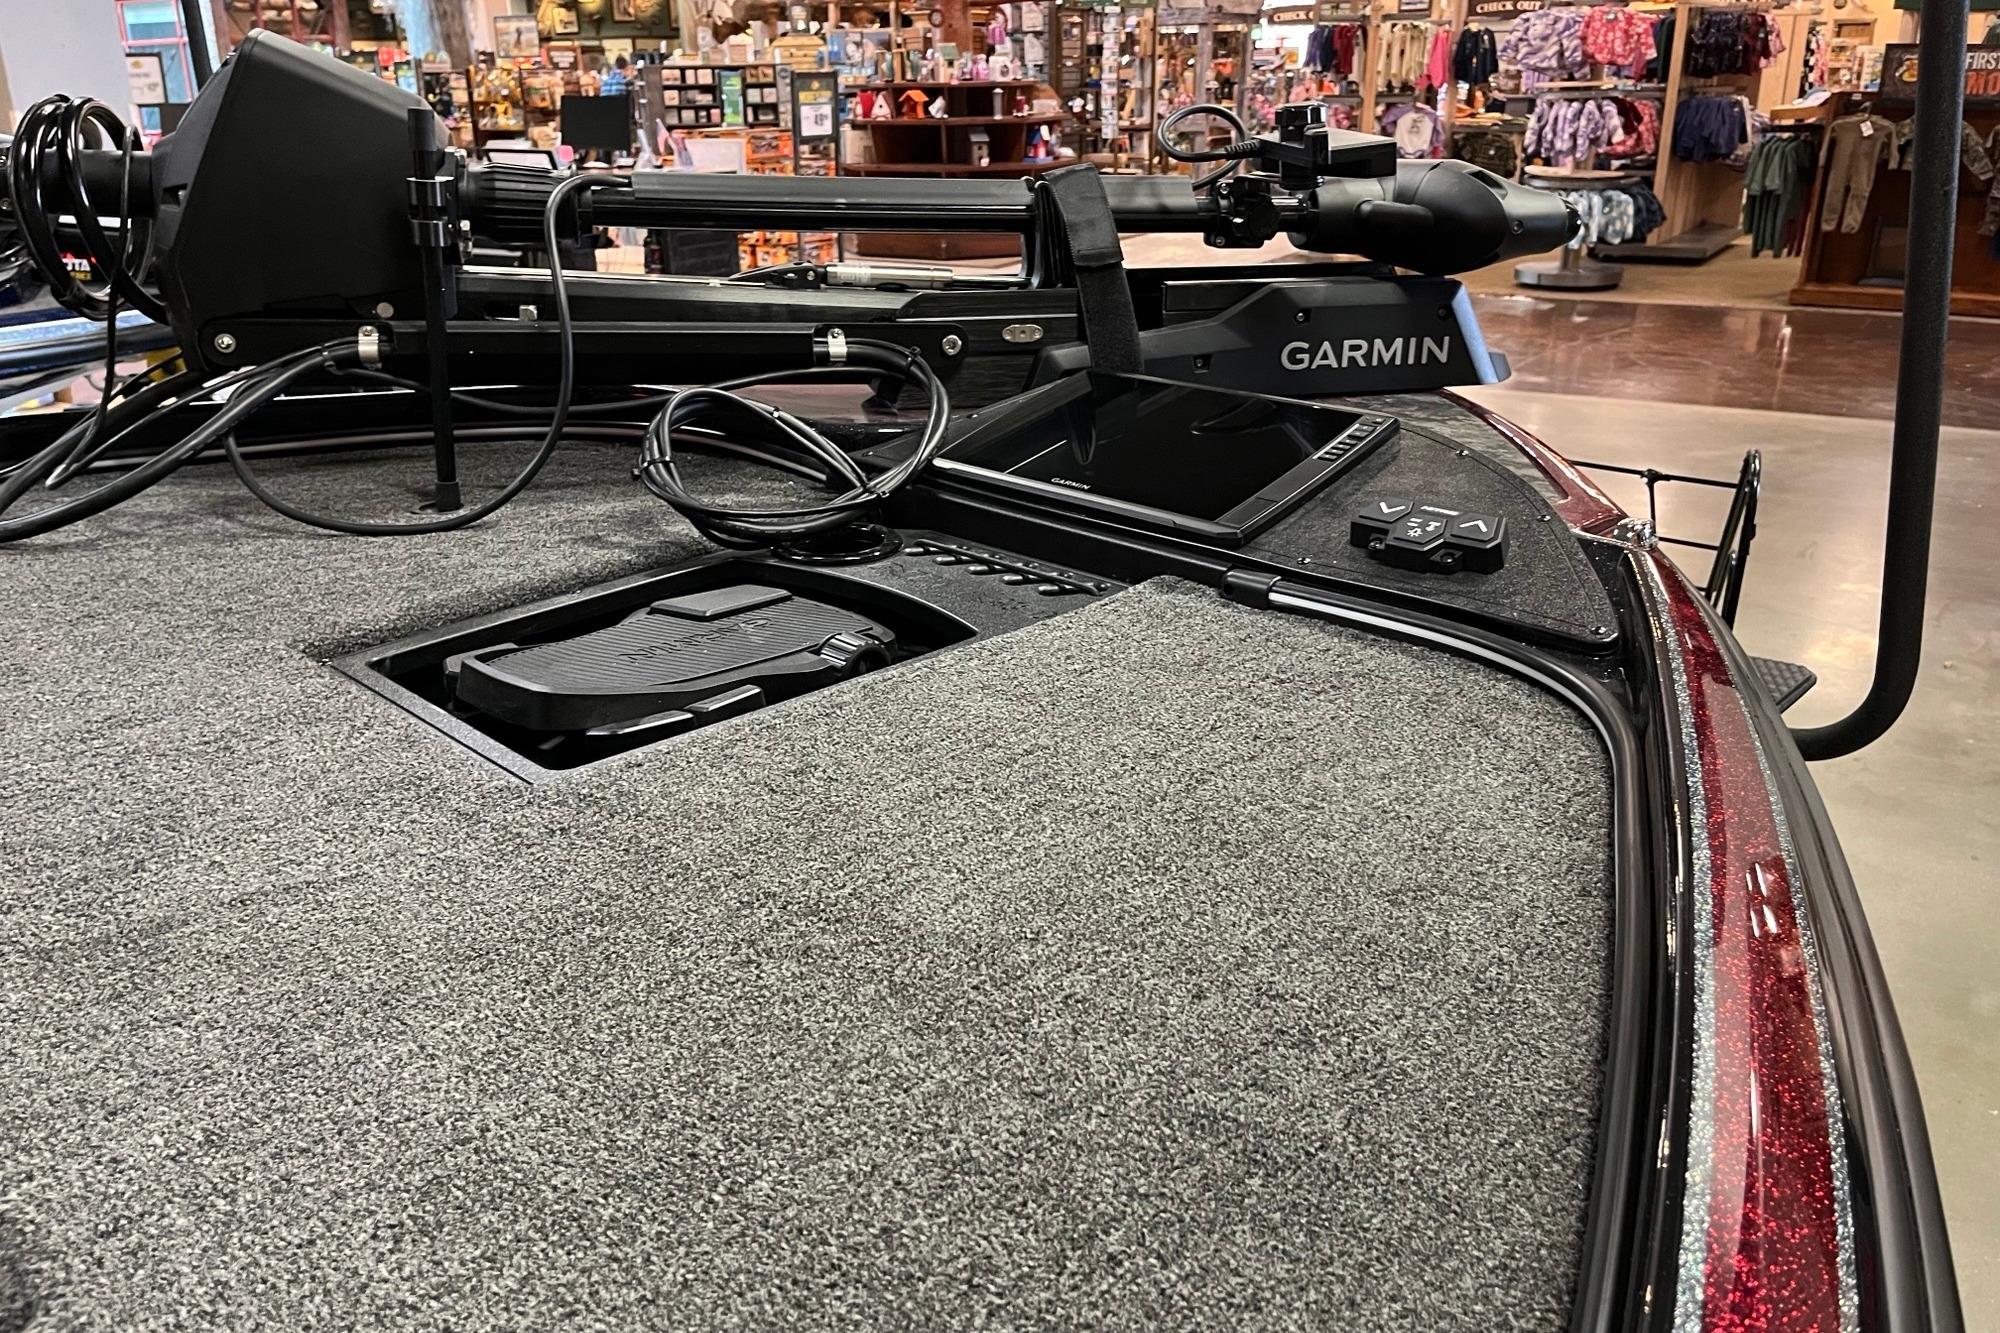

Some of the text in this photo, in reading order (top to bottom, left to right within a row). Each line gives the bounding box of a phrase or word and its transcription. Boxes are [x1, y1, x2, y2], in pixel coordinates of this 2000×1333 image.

[1476, 1, 1541, 13] CHECK OUT
[1273, 11, 1308, 22] CHECK
[1281, 336, 1450, 371] GARMIN
[1051, 477, 1091, 490] GARMIN
